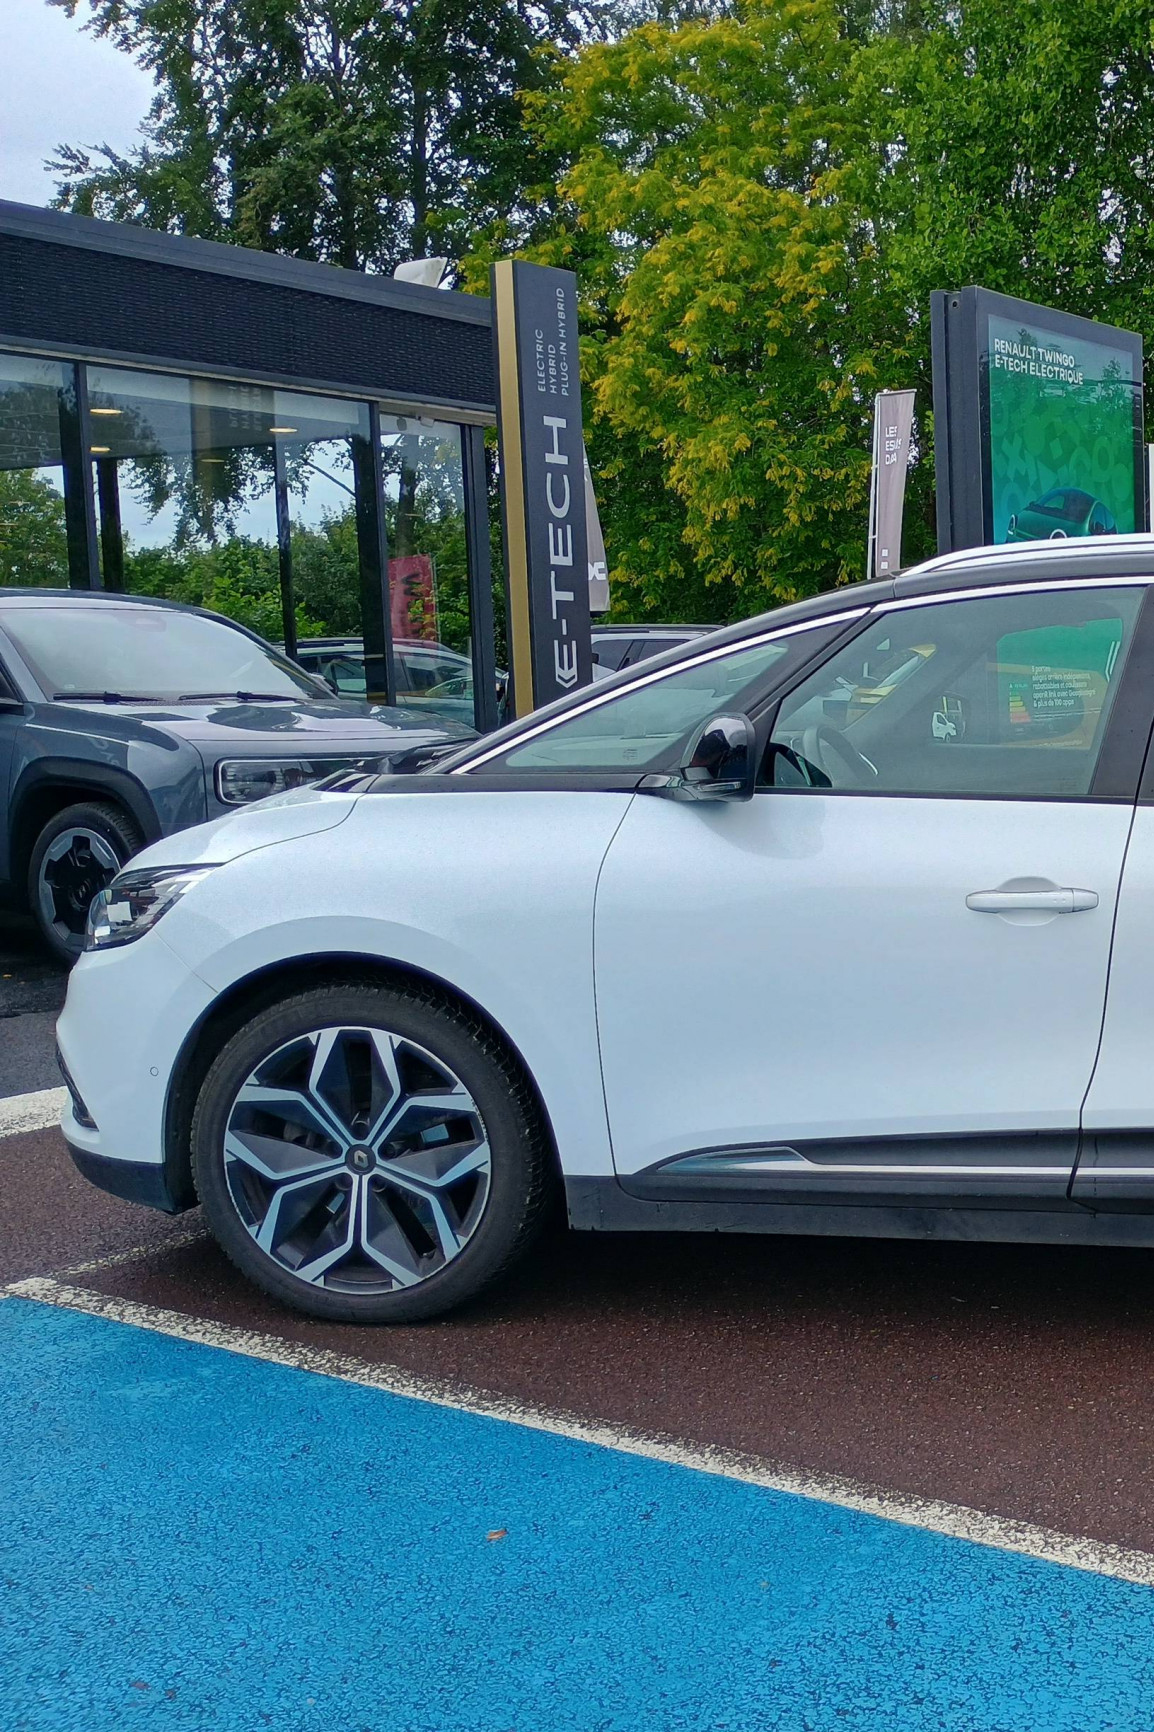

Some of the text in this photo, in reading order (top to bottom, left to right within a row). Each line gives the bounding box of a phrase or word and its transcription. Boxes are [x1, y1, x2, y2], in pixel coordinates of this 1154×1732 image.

[535, 328, 546, 392] ELECTRIC
[548, 344, 558, 394] HYBRID
[556, 287, 569, 396] PLUG-IN HYBRID
[994, 338, 1075, 368] RENAULT TWINGO
[994, 354, 1084, 385] E-TECH ELECTRIQUE
[543, 415, 578, 688] E-TECH
